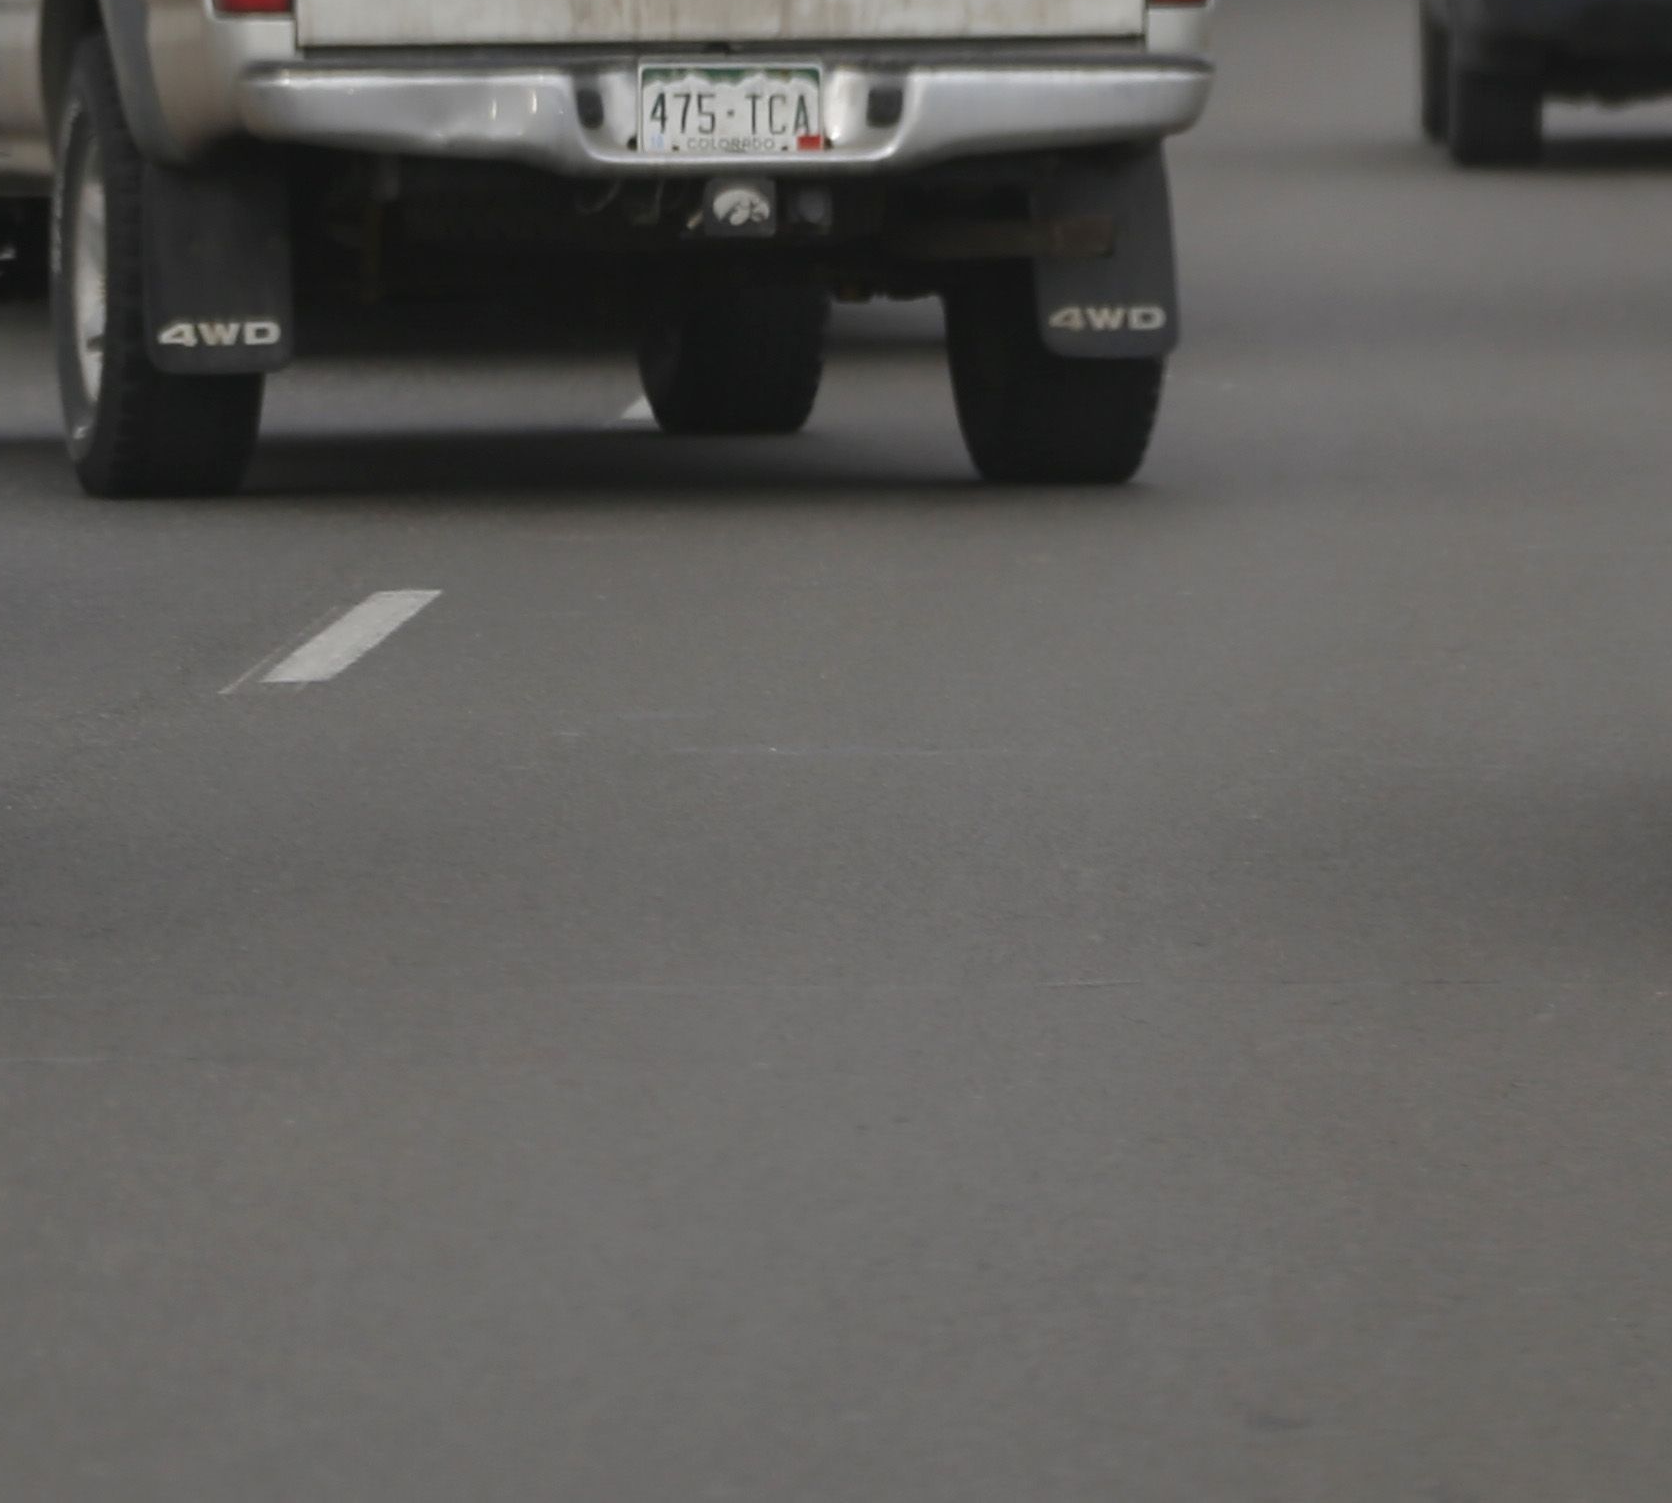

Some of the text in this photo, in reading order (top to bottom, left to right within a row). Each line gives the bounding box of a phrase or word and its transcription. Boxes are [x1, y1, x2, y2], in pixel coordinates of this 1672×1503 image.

[686, 137, 776, 150] COLORADO
[1048, 306, 1167, 331] 4WD
[157, 321, 281, 347] 4WD
